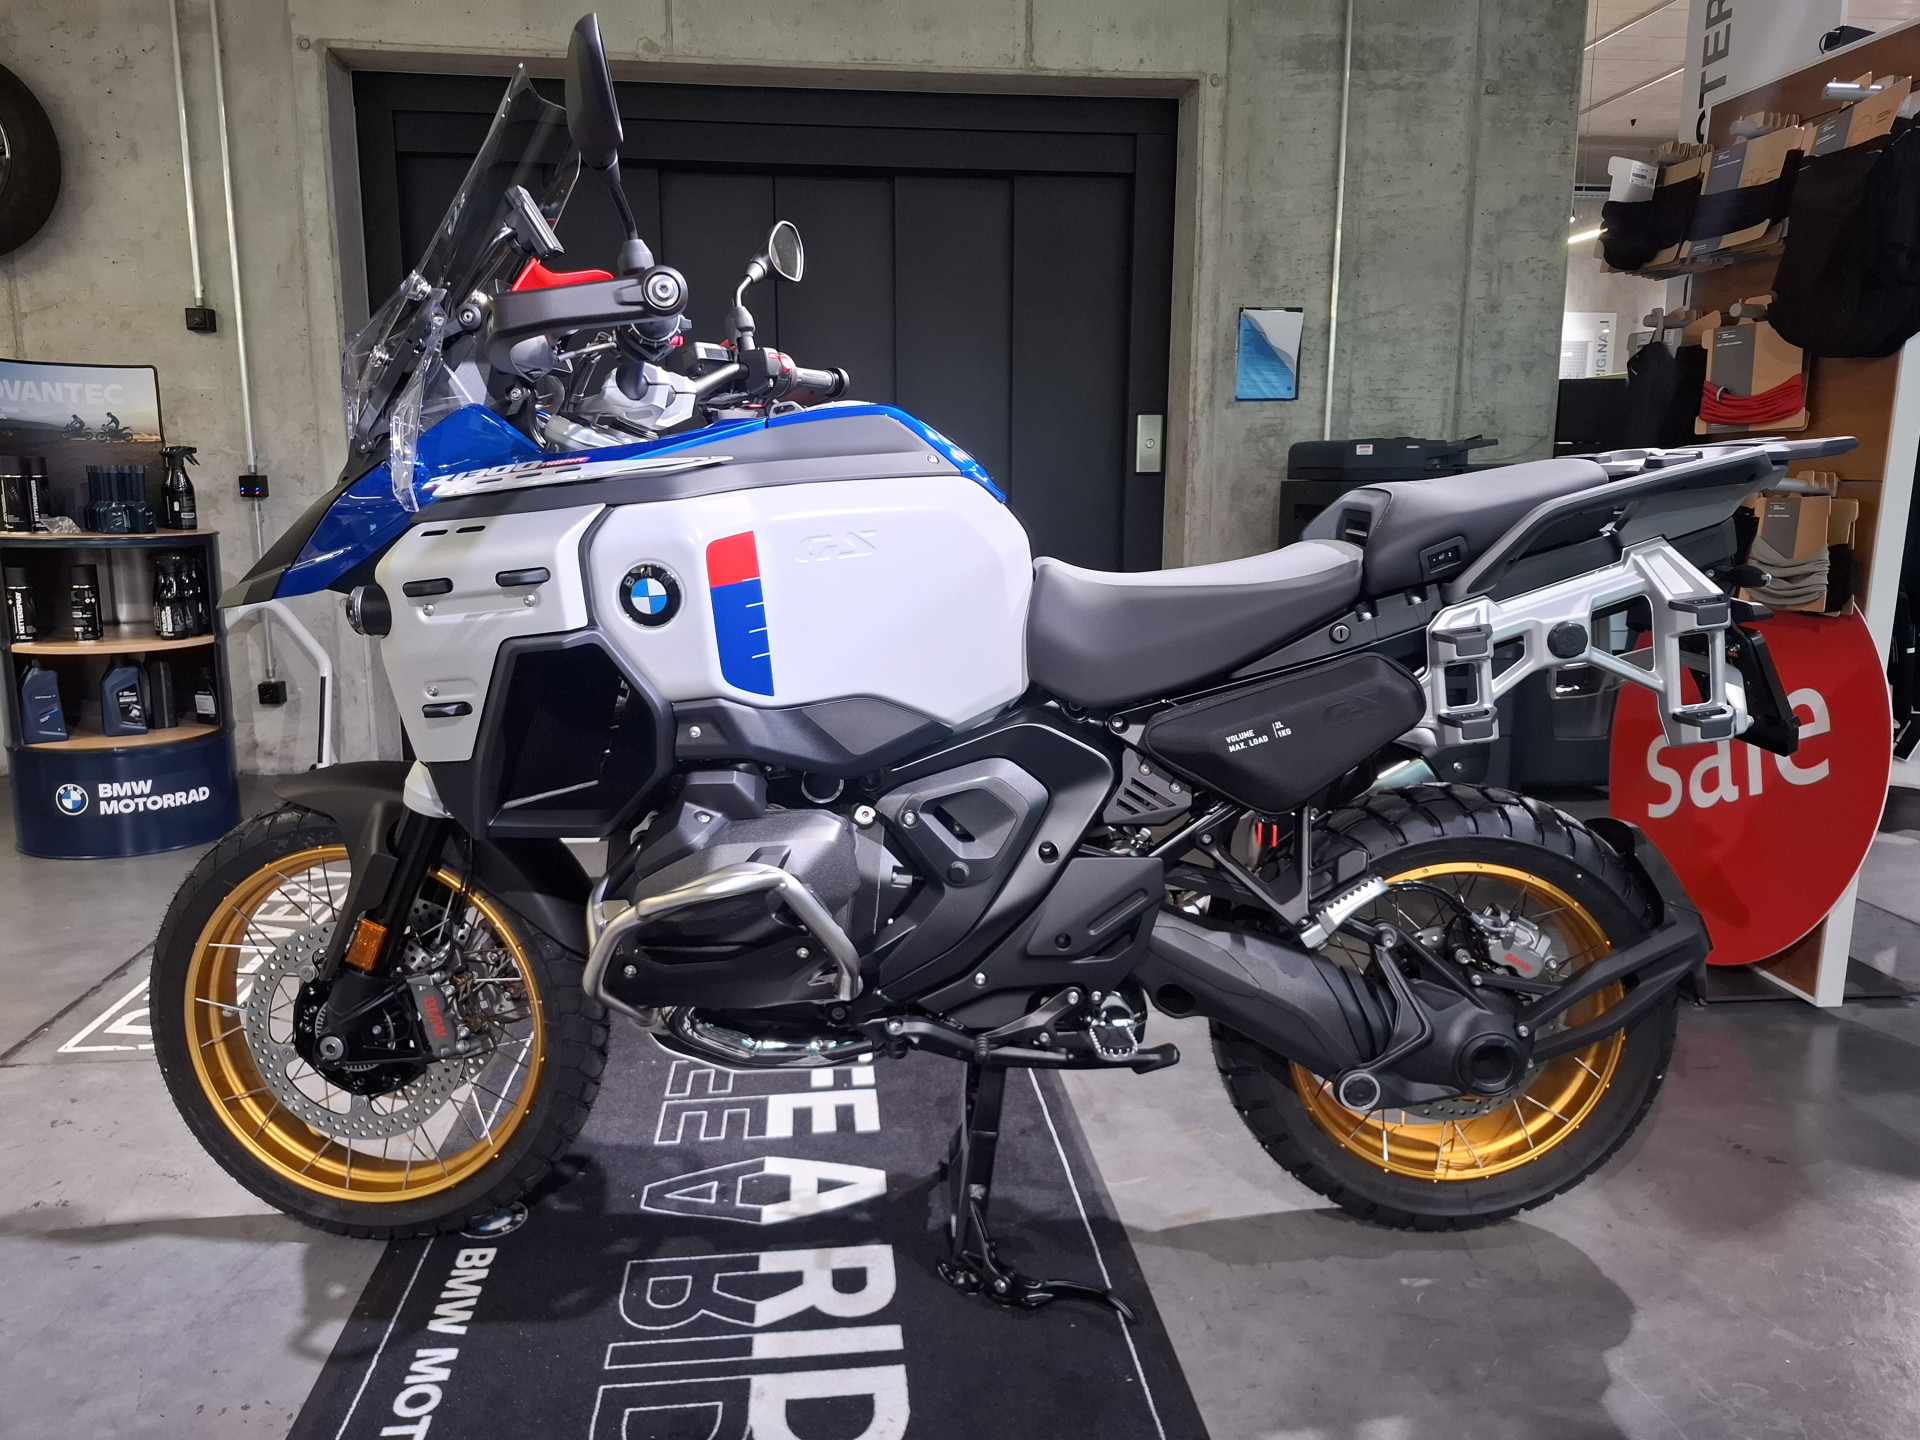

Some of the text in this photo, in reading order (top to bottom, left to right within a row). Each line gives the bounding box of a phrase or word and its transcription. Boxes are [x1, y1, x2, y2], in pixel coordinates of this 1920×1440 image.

[0, 379, 124, 405] VANTEC
[624, 567, 674, 588] BMW
[1225, 720, 1285, 744] VOLUME 2L
[1228, 728, 1292, 753] MAX. LOAD 1KG
[98, 779, 153, 798] BMW
[100, 783, 210, 816] MOTORRAD
[423, 995, 448, 1037] BMW
[379, 1247, 497, 1440] BMW MOT
